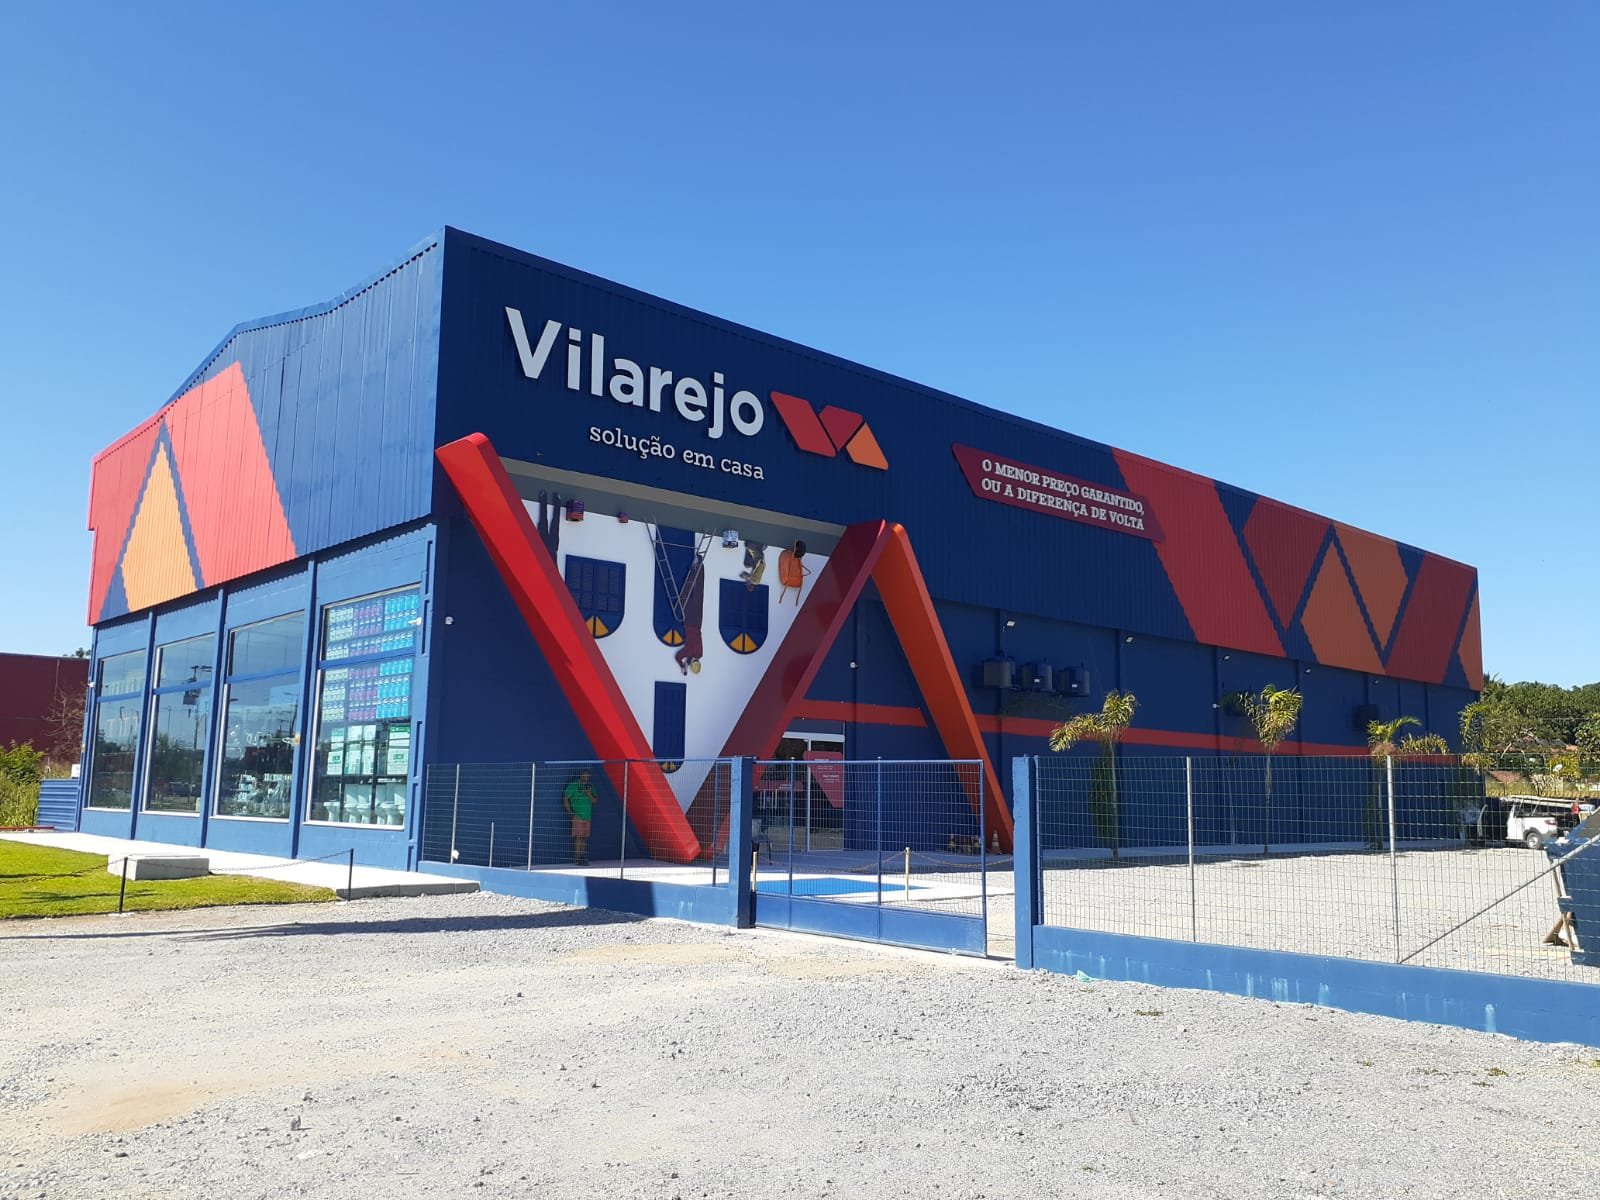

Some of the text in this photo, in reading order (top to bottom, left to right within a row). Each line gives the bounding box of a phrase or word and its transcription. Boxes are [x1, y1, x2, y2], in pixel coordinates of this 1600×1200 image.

[505, 306, 764, 439] Vilarejo
[589, 426, 765, 480] solução em casa
[981, 478, 1145, 531] OU A DIFERENÇA DE VOLTA
[982, 459, 1145, 516] O MENOR PREÇO GARANTIDO,
